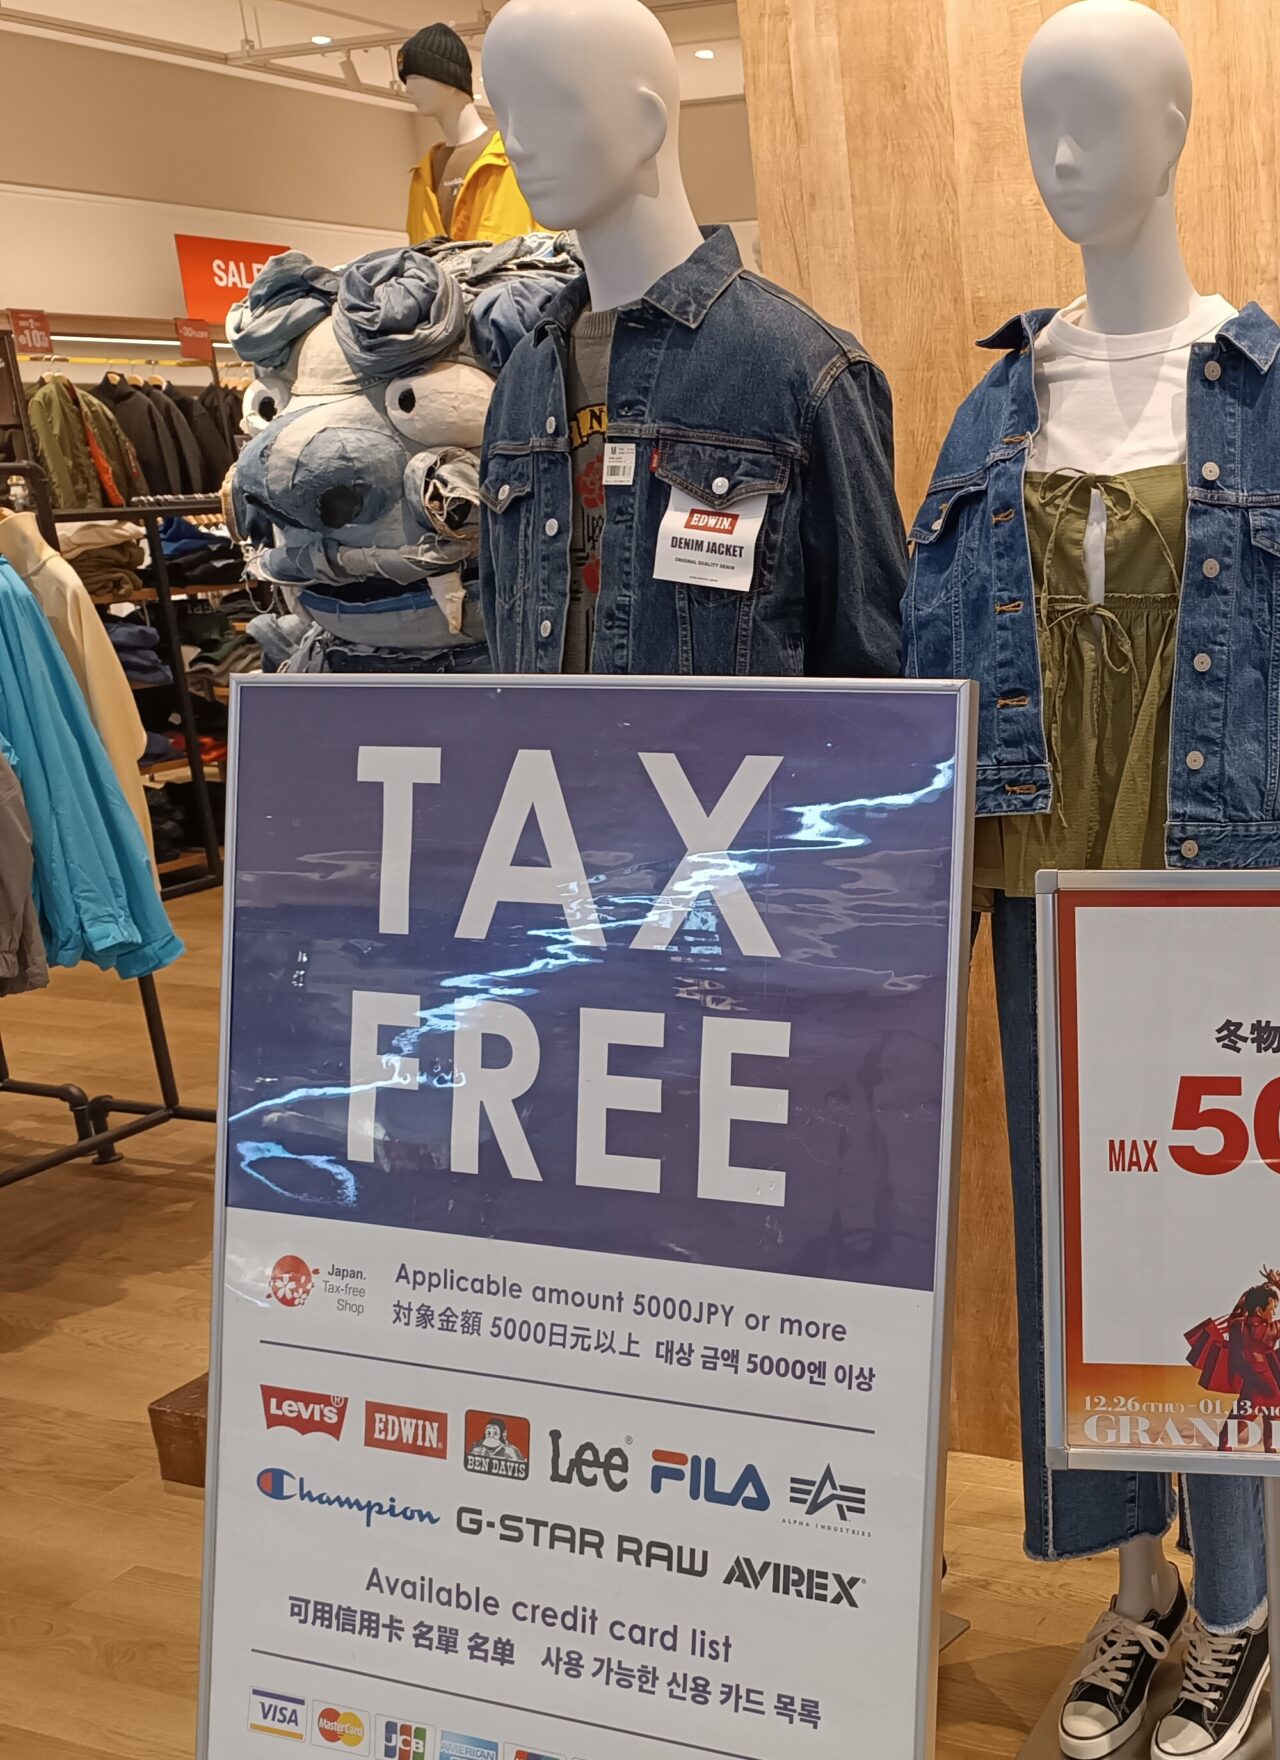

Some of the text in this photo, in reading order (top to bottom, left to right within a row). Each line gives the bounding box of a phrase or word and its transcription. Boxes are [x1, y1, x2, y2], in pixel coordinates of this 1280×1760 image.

[670, 536, 744, 558] DENIM JACKET
[698, 561, 718, 569] QUALITY
[356, 745, 785, 958] TAX
[346, 989, 792, 1207] FREE
[1108, 1139, 1159, 1173] MAX
[322, 1280, 366, 1298] Tax-free
[336, 1299, 365, 1316] Shop
[395, 1263, 848, 1342] Applicable amount 5000JPY or more
[392, 1300, 641, 1358] 対象金額 5000日元以上
[655, 1340, 876, 1392] 대상 금액 5000엔 이상
[373, 1412, 440, 1449] EDWIN
[1083, 1413, 1263, 1449] GRAND
[467, 1456, 526, 1479] BEN DAVIS
[549, 1429, 629, 1492] Lee
[650, 1449, 771, 1512] FILA
[257, 1467, 441, 1527] Champion
[456, 1506, 709, 1578] G-STAR RAW
[782, 1518, 872, 1538] ALPHA INDUSTRIES
[722, 1555, 861, 1609] AVIREX
[288, 1595, 515, 1667] 可用信用卡 名單 名单
[365, 1567, 732, 1663] Available credit card list
[541, 1646, 822, 1730] 사용 가능한 신용 카드 목록
[259, 1701, 299, 1727] VISA
[319, 1718, 364, 1737] MasterCard
[384, 1733, 426, 1753] JCB
[440, 1741, 497, 1760] AMERICAN
